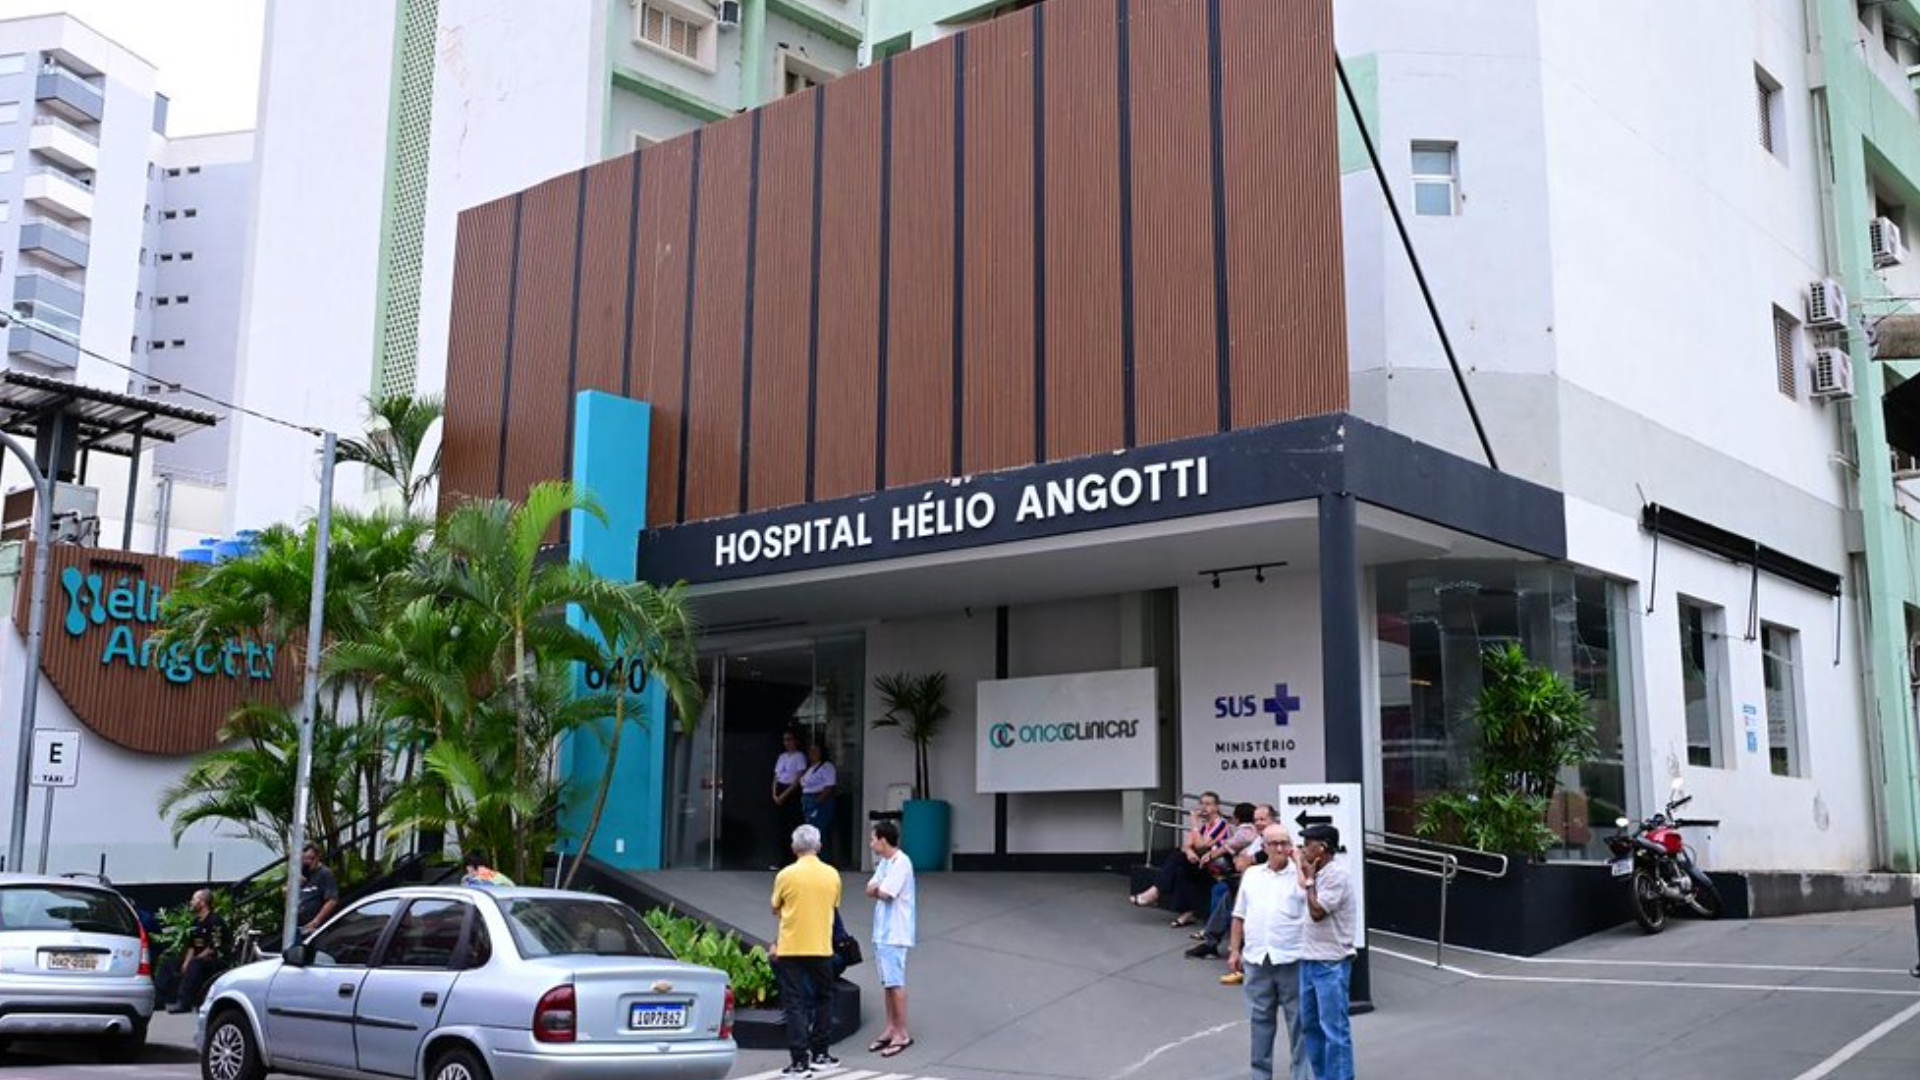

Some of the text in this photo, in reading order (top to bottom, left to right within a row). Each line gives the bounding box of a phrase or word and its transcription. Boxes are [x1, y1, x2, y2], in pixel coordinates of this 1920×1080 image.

[714, 456, 1209, 567] HOSPITAL HÉLIO ANGOTTI
[62, 565, 163, 636] Héli
[1214, 694, 1257, 719] SUS
[50, 742, 63, 764] E
[1215, 738, 1296, 753] MINISTÉRIO
[1221, 755, 1287, 771] DA SAÚDE
[1287, 792, 1340, 808] RECEPÇÃO
